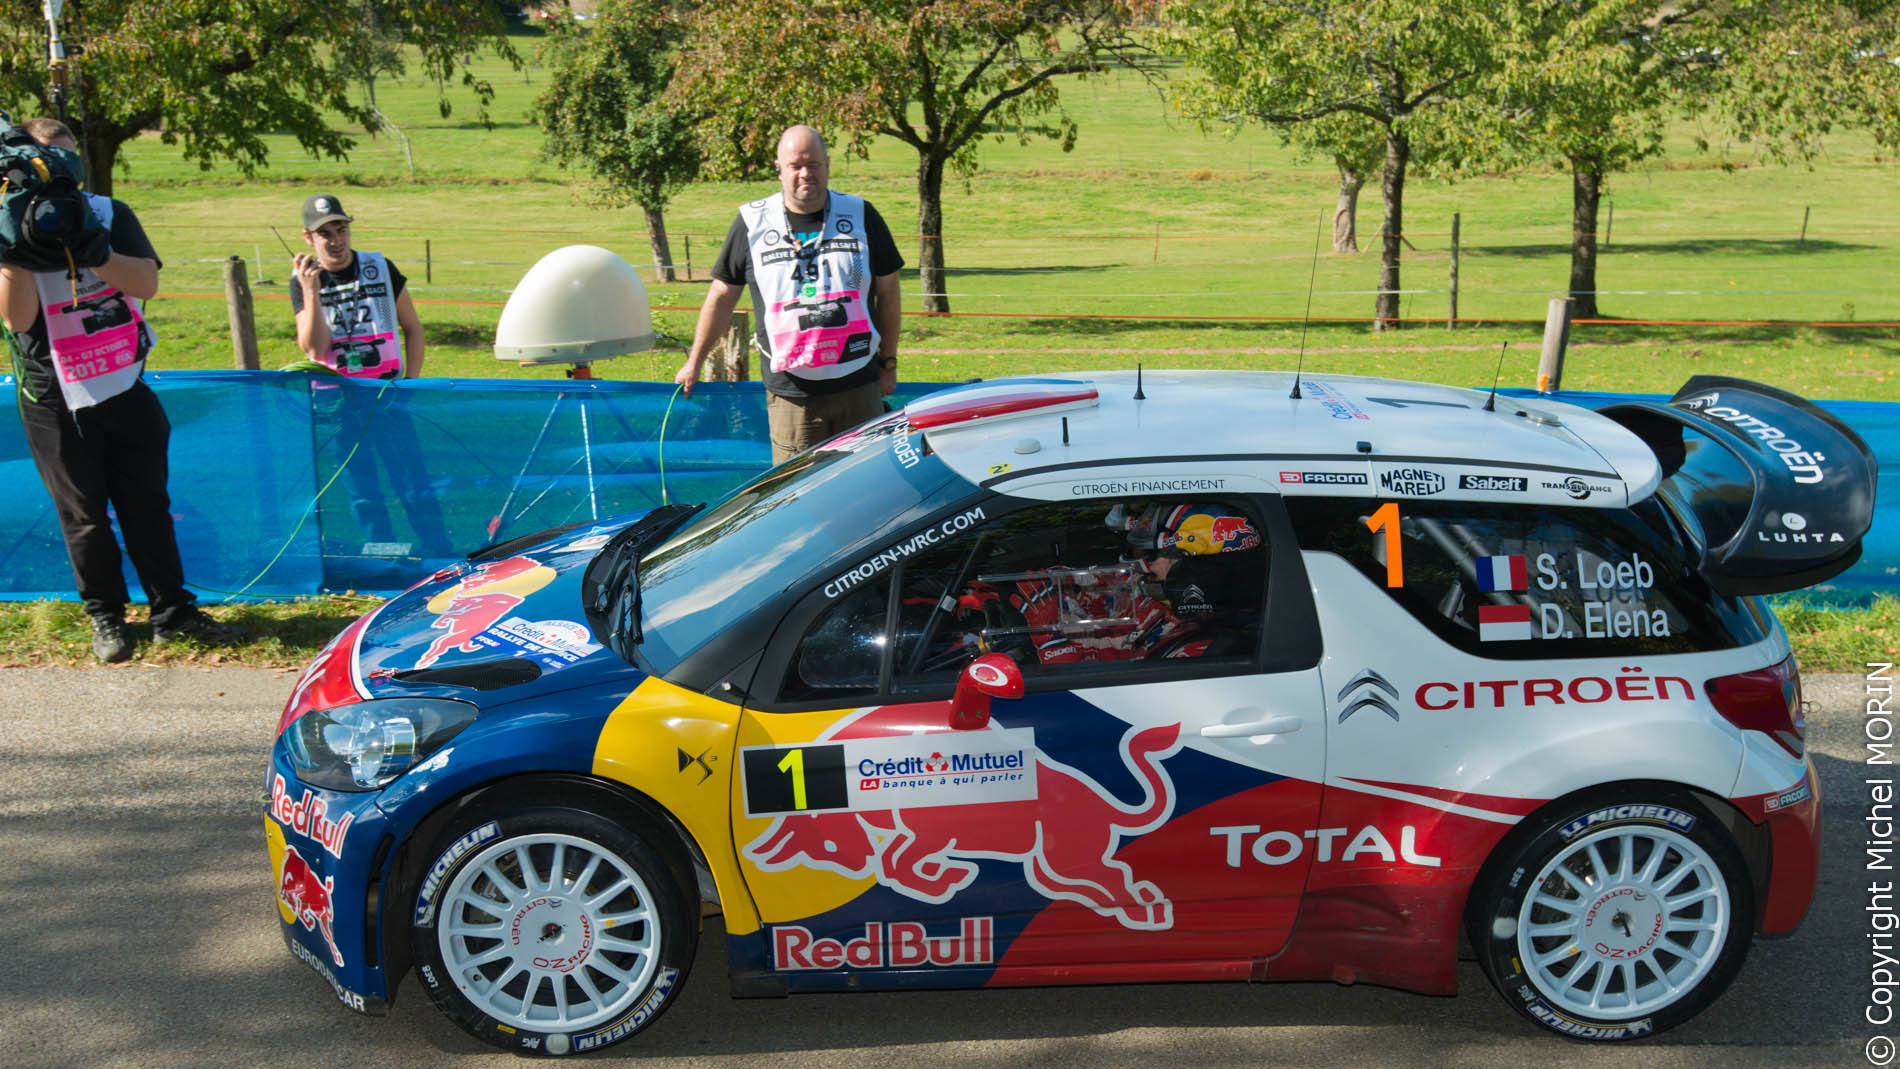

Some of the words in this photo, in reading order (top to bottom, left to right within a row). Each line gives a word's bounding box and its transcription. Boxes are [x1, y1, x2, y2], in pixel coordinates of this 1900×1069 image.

[65, 358, 108, 380] 2012
[892, 420, 920, 469] CITROËN
[1704, 407, 1825, 484] CITROËN
[1072, 480, 1128, 496] CITROËN
[1132, 479, 1225, 492] FINANCEMENT
[1303, 473, 1367, 485] FACOM
[1465, 475, 1521, 491] Sabelt
[824, 506, 986, 599] CITROEN-WRC.COM
[1365, 503, 1404, 588] 1
[1758, 531, 1844, 543] LUHTA
[1536, 553, 1568, 590] S.
[1577, 553, 1654, 589] Loeb
[487, 627, 528, 646] RALLYE
[1540, 603, 1573, 640] D.
[1584, 602, 1671, 639] Elena
[1414, 666, 1696, 710] CITROËN
[777, 749, 807, 810] 1
[858, 756, 924, 777] Crédit
[952, 750, 1024, 772] Mutuel
[861, 780, 879, 790] LA
[883, 779, 933, 789] banque
[940, 776, 946, 785] à
[953, 774, 974, 785] qui
[981, 772, 1024, 785] parler
[272, 772, 313, 837] Red
[310, 795, 355, 859] Bull
[1587, 805, 1692, 827] MICHELIN
[421, 823, 496, 902] MICHELIN
[1209, 823, 1442, 868] TOTAL
[567, 914, 591, 964] RACING
[773, 922, 884, 971] Red
[888, 916, 994, 967] Bull
[1626, 912, 1663, 957] RACING
[579, 989, 665, 1050] MICHELIN
[1530, 1005, 1627, 1039] MICHELIN
